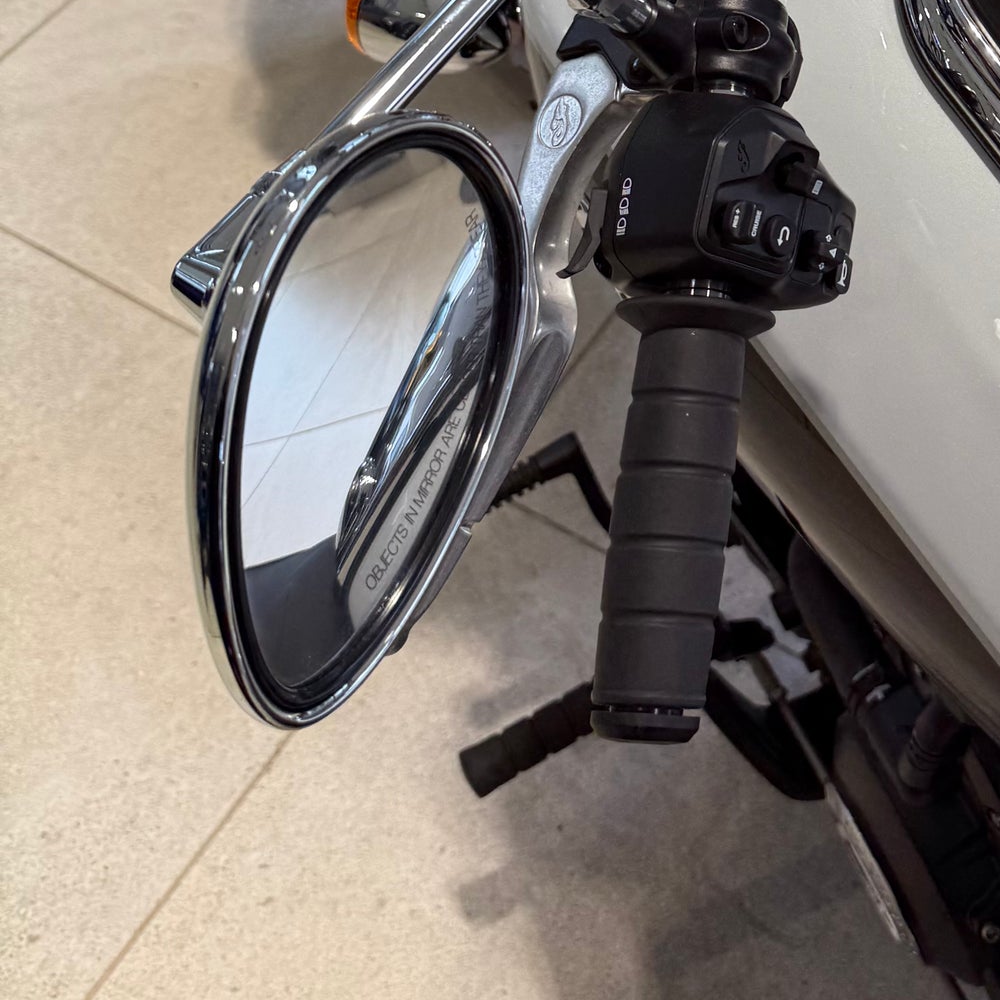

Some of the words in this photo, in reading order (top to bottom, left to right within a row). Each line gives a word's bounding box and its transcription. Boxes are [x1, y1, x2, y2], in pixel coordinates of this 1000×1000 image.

[751, 210, 762, 237] CRUISE
[365, 523, 409, 591] OBJECTS
[404, 506, 419, 525] IN
[412, 448, 447, 508] MIRROR
[441, 416, 461, 448] ARE
